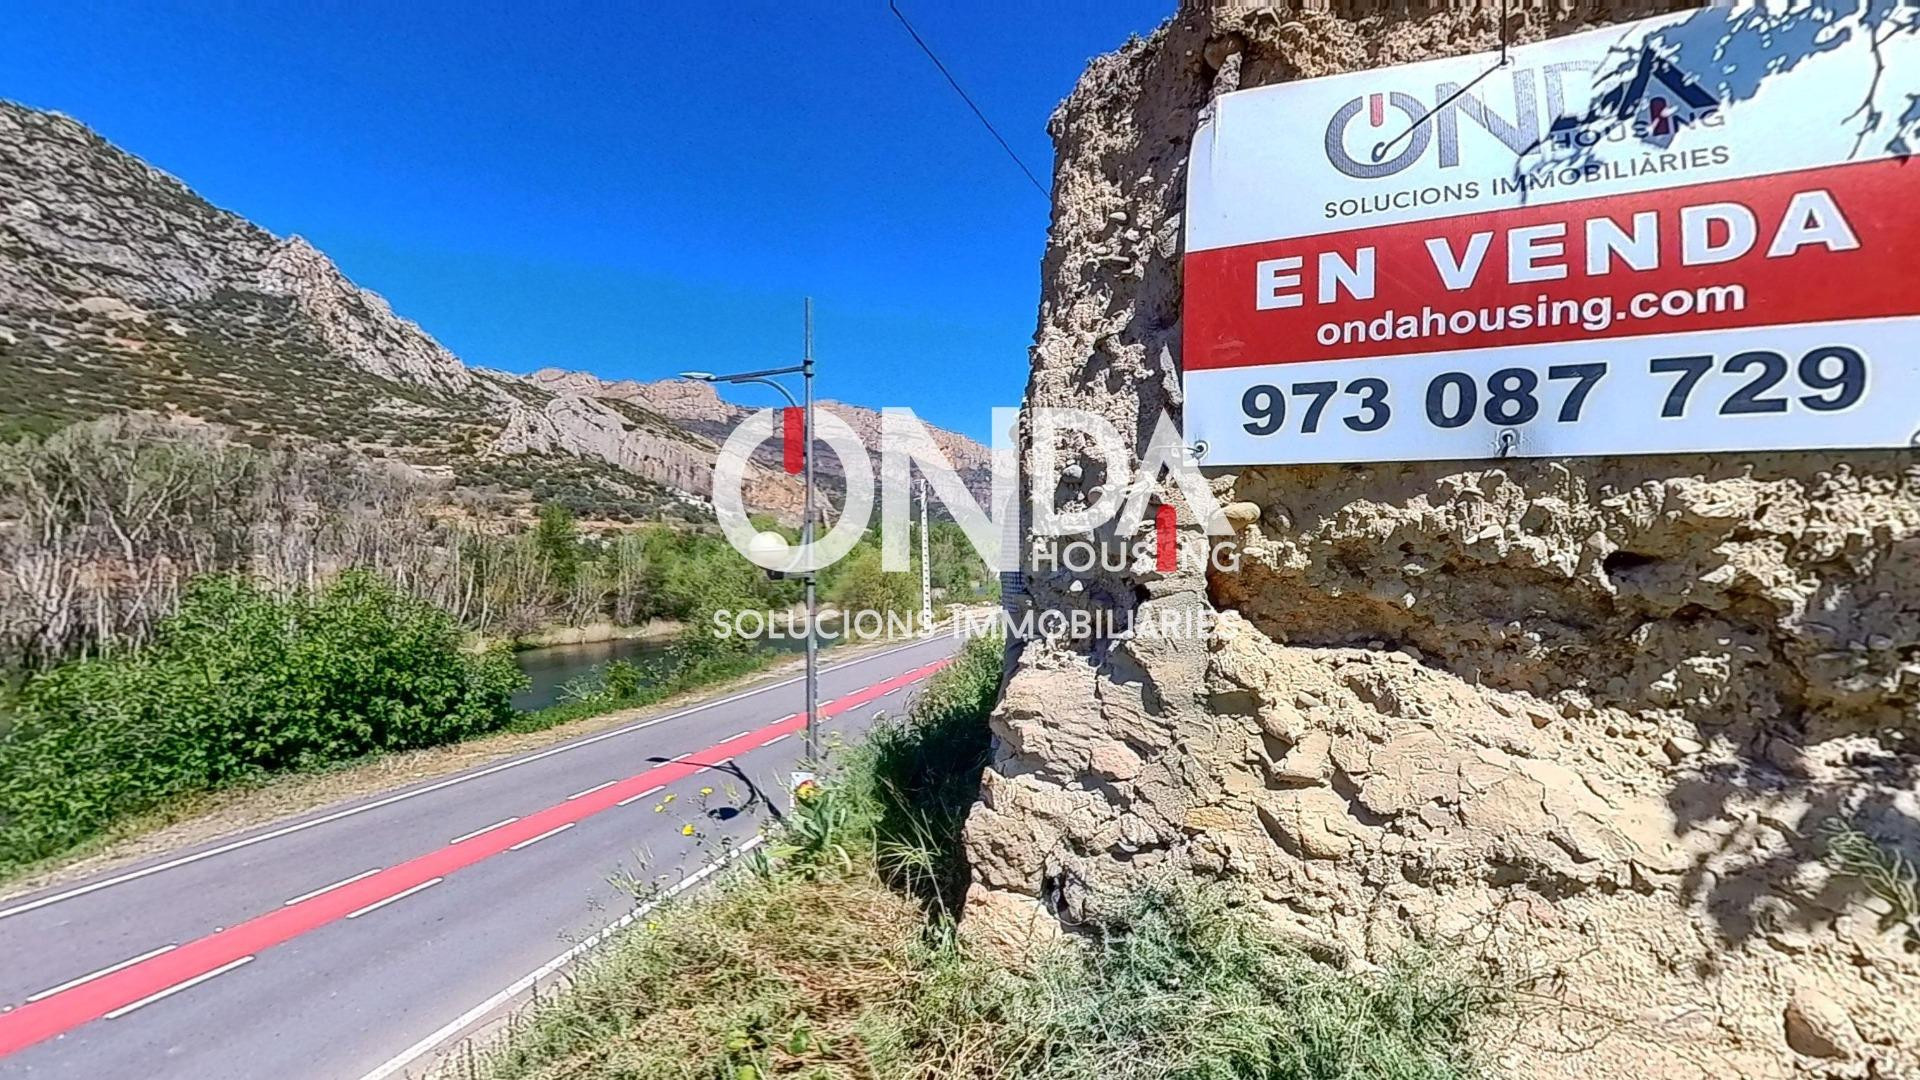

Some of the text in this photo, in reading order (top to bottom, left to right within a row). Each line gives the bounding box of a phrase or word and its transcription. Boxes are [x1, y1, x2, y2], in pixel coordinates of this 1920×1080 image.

[1550, 108, 1726, 151] HOUSING
[1324, 145, 1730, 219] SOLUCIONS IMMOBILIÀRIES
[1255, 190, 1860, 312] EN VENDA
[1316, 284, 1746, 346] ondahousing.com
[1241, 345, 1868, 435] 973 087 729
